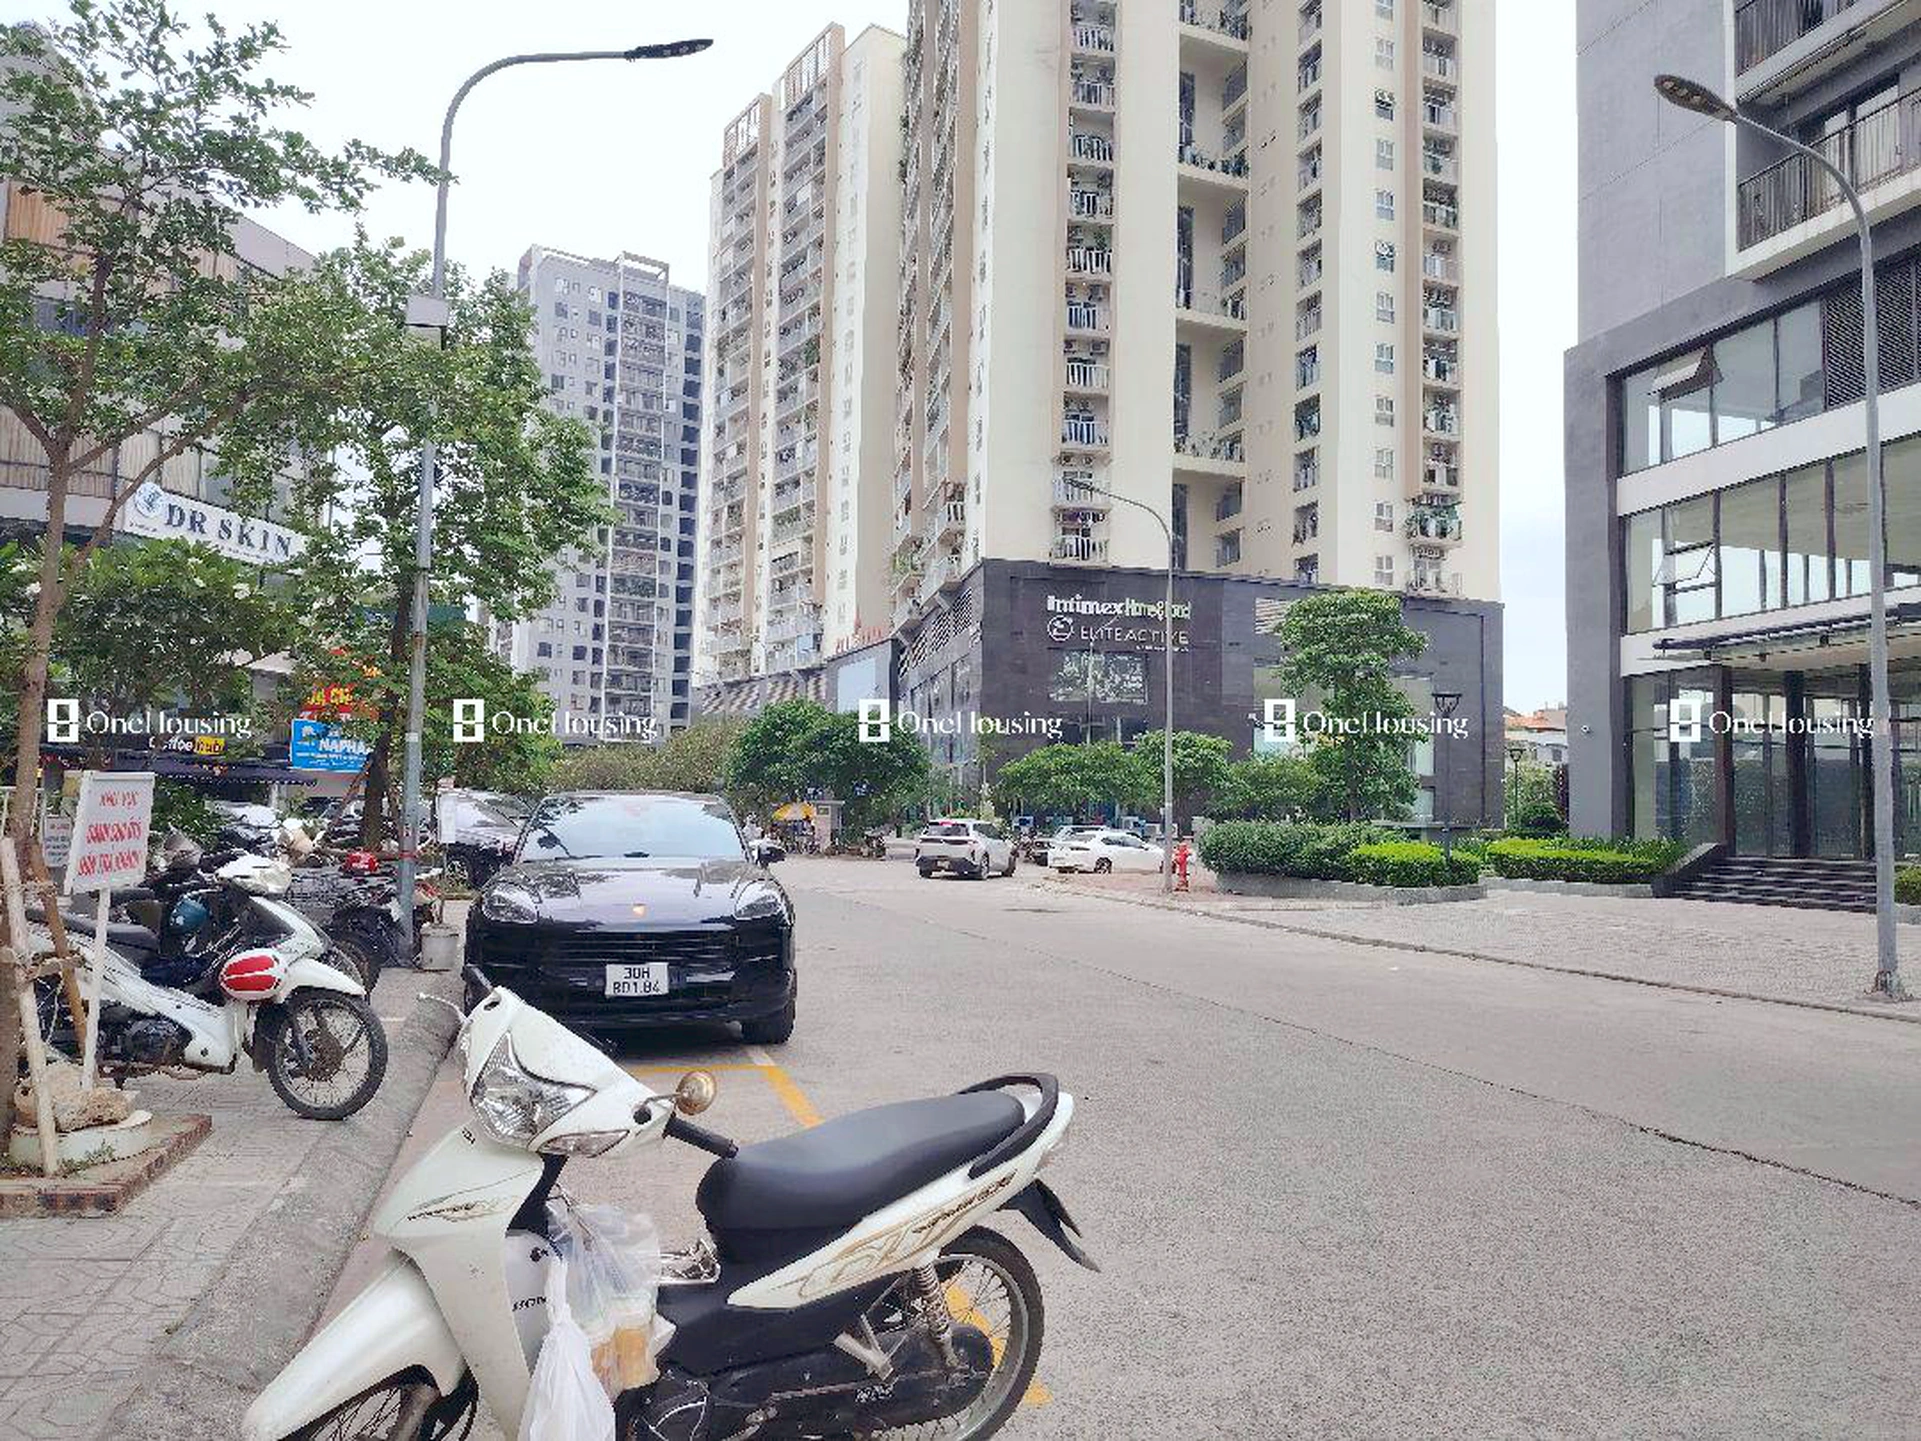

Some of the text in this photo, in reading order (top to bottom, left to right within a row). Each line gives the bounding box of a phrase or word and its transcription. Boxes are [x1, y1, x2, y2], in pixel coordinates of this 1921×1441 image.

[165, 503, 206, 535] DR
[218, 518, 292, 557] SKIN
[624, 967, 650, 979] 30H
